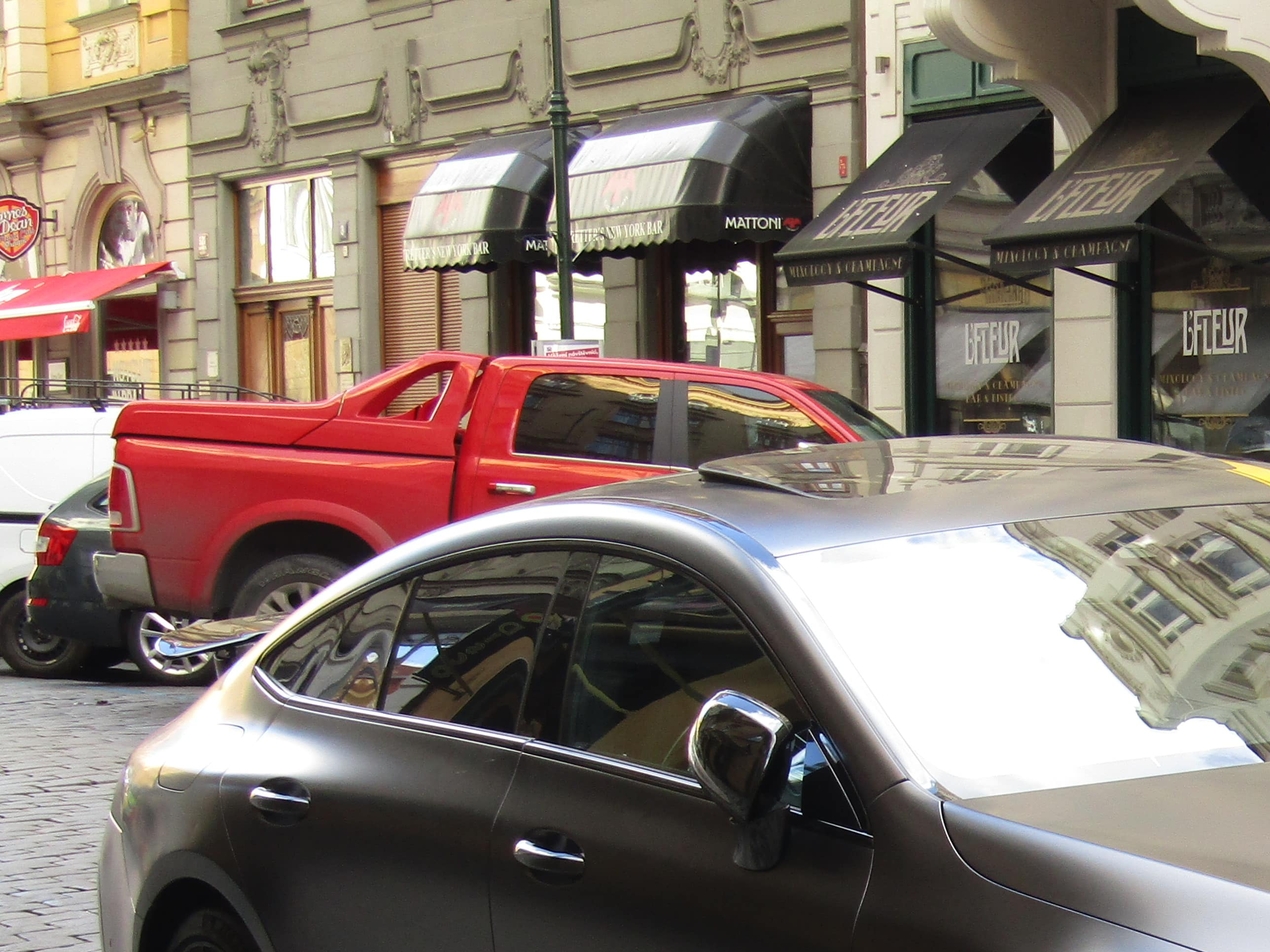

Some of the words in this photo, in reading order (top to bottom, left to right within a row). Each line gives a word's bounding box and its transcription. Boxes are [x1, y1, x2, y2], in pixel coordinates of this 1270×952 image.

[624, 222, 646, 238] YORK
[647, 220, 663, 236] BAR
[725, 216, 782, 230] MATTONI
[452, 242, 471, 257] YORK
[472, 240, 490, 255] BAR
